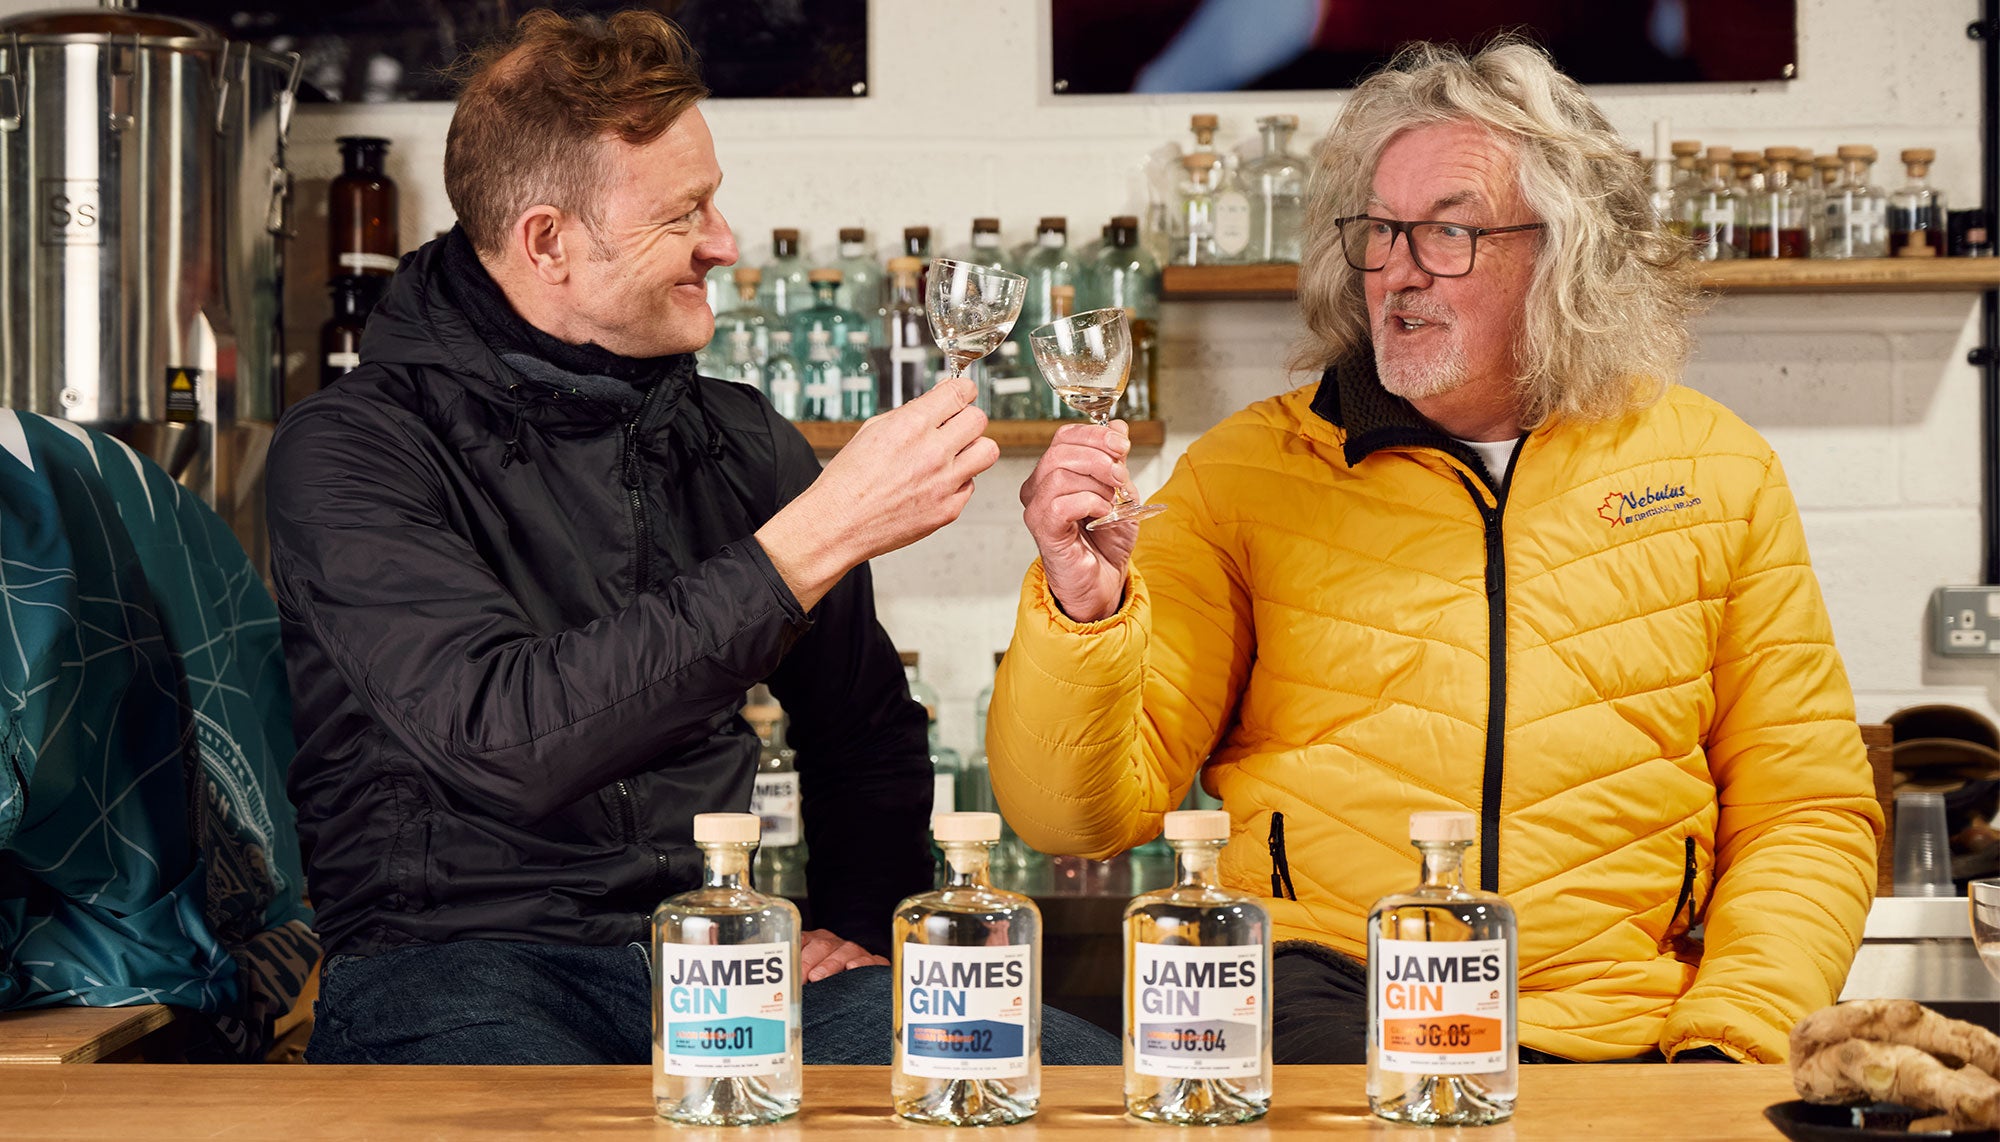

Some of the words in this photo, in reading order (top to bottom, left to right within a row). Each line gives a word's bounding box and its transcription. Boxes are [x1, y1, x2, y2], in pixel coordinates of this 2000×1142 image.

[50, 194, 96, 228] Ss
[1620, 484, 1685, 512] Nebulus
[670, 956, 783, 986] JAMES
[910, 960, 1023, 988] JAMES
[1143, 960, 1256, 988] JAMES
[1386, 954, 1500, 983] JAMES
[670, 986, 727, 1014] GIN
[910, 987, 966, 1016] GIN
[1142, 987, 1199, 1016] GIN
[1385, 982, 1443, 1011] GIN
[701, 1026, 753, 1050] JG.01
[1171, 1029, 1226, 1052] JG.04
[1416, 1024, 1471, 1047] JG.05
